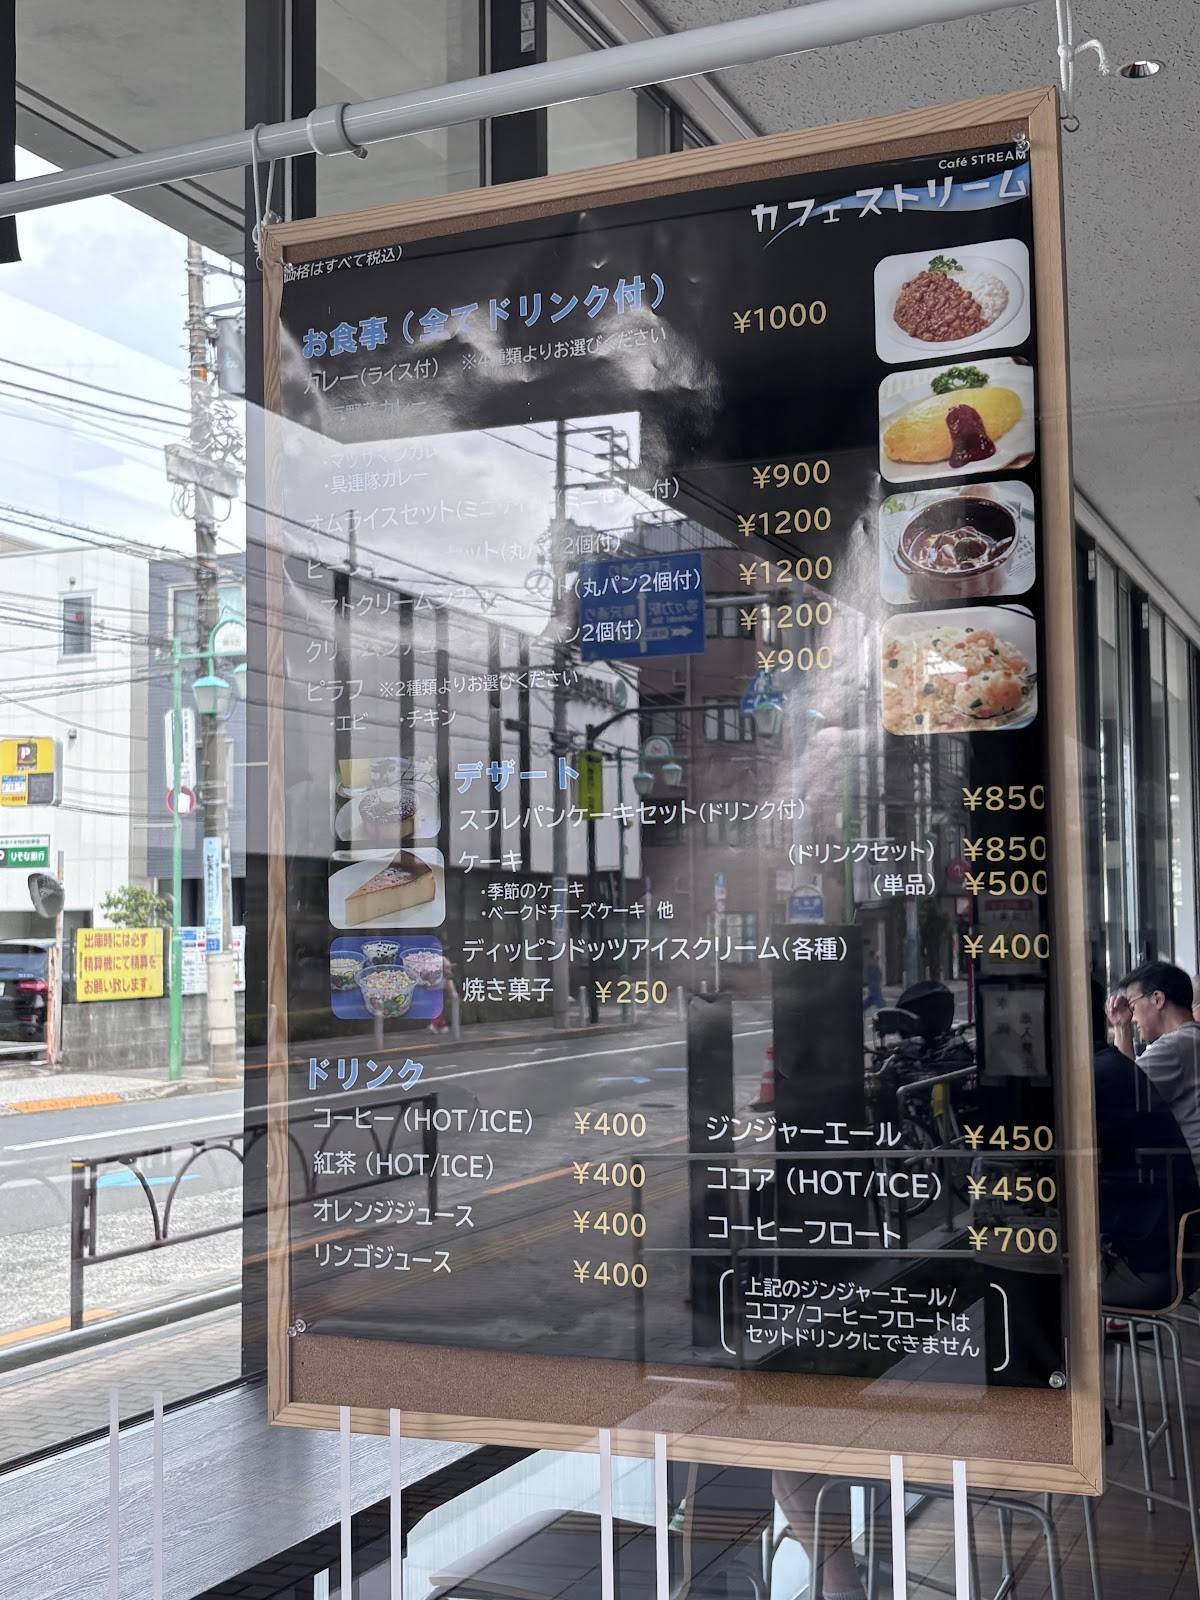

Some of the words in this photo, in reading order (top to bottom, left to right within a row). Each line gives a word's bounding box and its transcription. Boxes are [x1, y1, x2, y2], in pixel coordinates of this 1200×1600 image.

[938, 156, 968, 170] Café
[970, 150, 1026, 166] STREAM
[751, 169, 1028, 233] カフェストリーム
[303, 357, 440, 395] カレー(ライス付)
[733, 300, 827, 334] ¥1000
[752, 459, 831, 489] ¥900
[737, 506, 832, 536] ¥1200
[739, 556, 833, 585] ¥1200
[740, 601, 833, 630] ¥1200
[306, 679, 363, 702] ピラフ
[757, 646, 833, 673] ¥900
[454, 756, 580, 795] デザート
[962, 785, 1045, 812] ¥850
[458, 849, 523, 874] ケーキ
[962, 836, 1047, 862] ¥850
[964, 870, 1047, 897] ¥500
[656, 900, 674, 919] 他
[962, 933, 1050, 960] ¥400
[462, 975, 554, 1004] 焼き菓子
[594, 979, 669, 1005] ¥250
[307, 1057, 425, 1092] ドリンク
[574, 1110, 647, 1138] ¥400
[705, 1114, 902, 1146] ジンジャーエール
[963, 1124, 1054, 1152] ¥450
[573, 1160, 646, 1189] ¥400
[966, 1175, 1057, 1203] ¥450
[313, 1198, 476, 1228] オレンジジュース
[573, 1209, 647, 1238] ¥400
[707, 1214, 902, 1249] コーヒーフロート
[968, 1225, 1058, 1254] ¥700
[314, 1243, 452, 1274] リンゴジュース
[573, 1259, 648, 1289] ¥400
[746, 1327, 980, 1358] セットドリンクにできません
